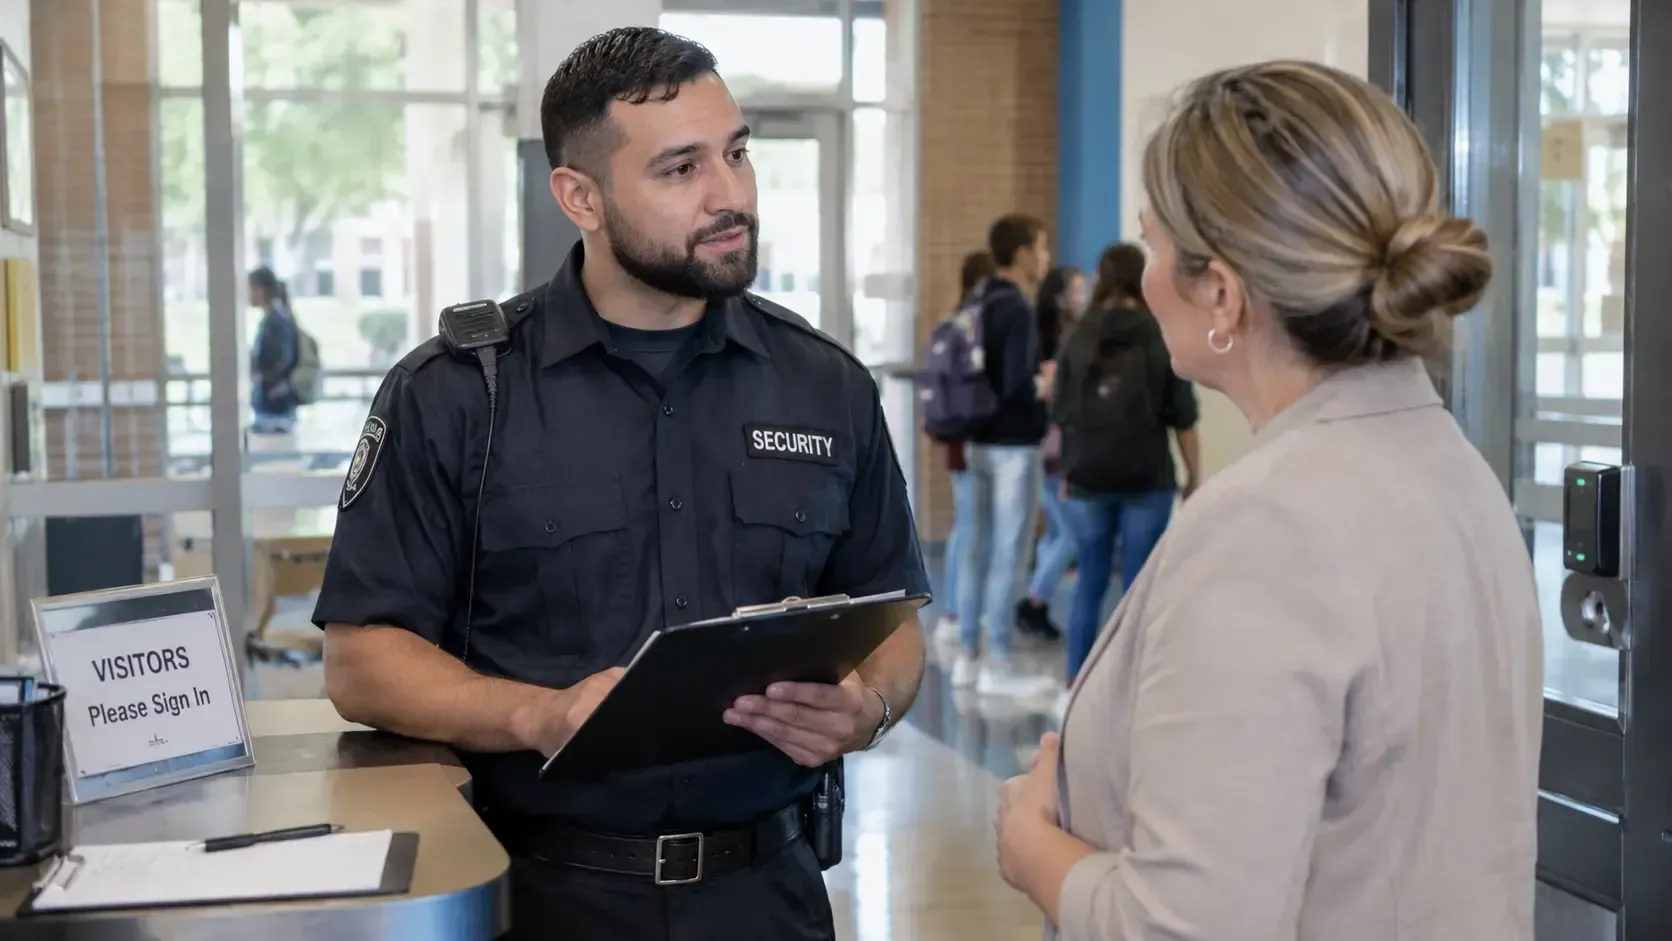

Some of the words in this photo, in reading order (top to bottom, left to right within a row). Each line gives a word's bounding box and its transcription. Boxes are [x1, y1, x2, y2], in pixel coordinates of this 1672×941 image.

[752, 430, 833, 457] SECURITY
[92, 646, 190, 682] VISITORS
[88, 700, 148, 727] Please
[152, 691, 190, 716] Sign
[193, 686, 211, 707] In
